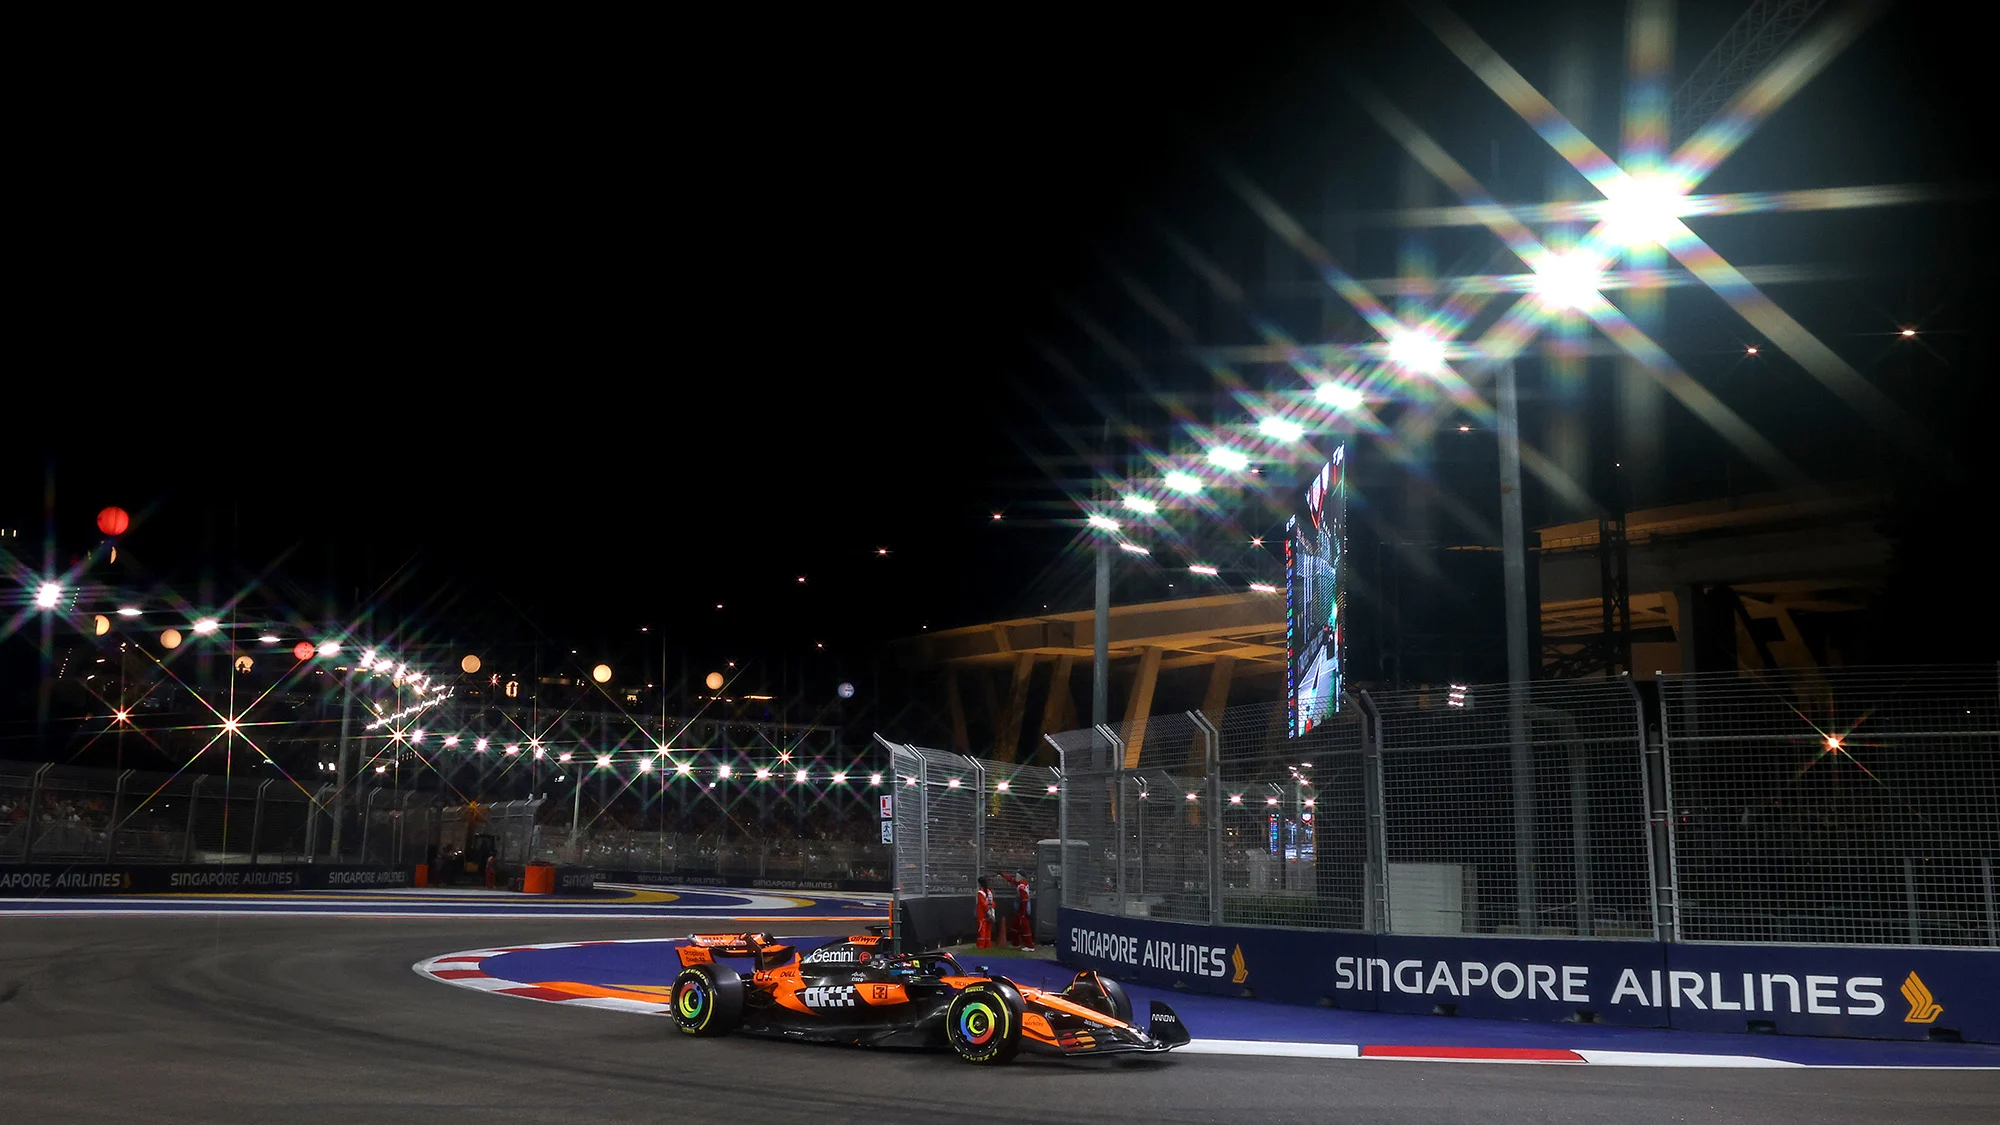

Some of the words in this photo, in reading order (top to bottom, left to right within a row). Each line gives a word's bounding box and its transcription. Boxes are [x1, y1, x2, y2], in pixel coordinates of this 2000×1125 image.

[0, 873, 51, 888] APORE
[55, 872, 121, 888] AIRLINES
[170, 872, 239, 887] SINGAPORE
[242, 871, 293, 885] AIRLINES
[328, 871, 375, 884] SINGAPORE
[376, 870, 406, 883] AIRLINES
[753, 879, 796, 887] SINGAPORE
[798, 881, 833, 889] AIRLINES
[812, 947, 854, 963] Gemini
[1071, 927, 1138, 965] SINGAPORE
[1143, 939, 1227, 978] AIRLINES
[1335, 956, 1590, 1003] SINGAPORE
[1610, 968, 1886, 1016] AIRLINES
[804, 985, 856, 1008] OKX
